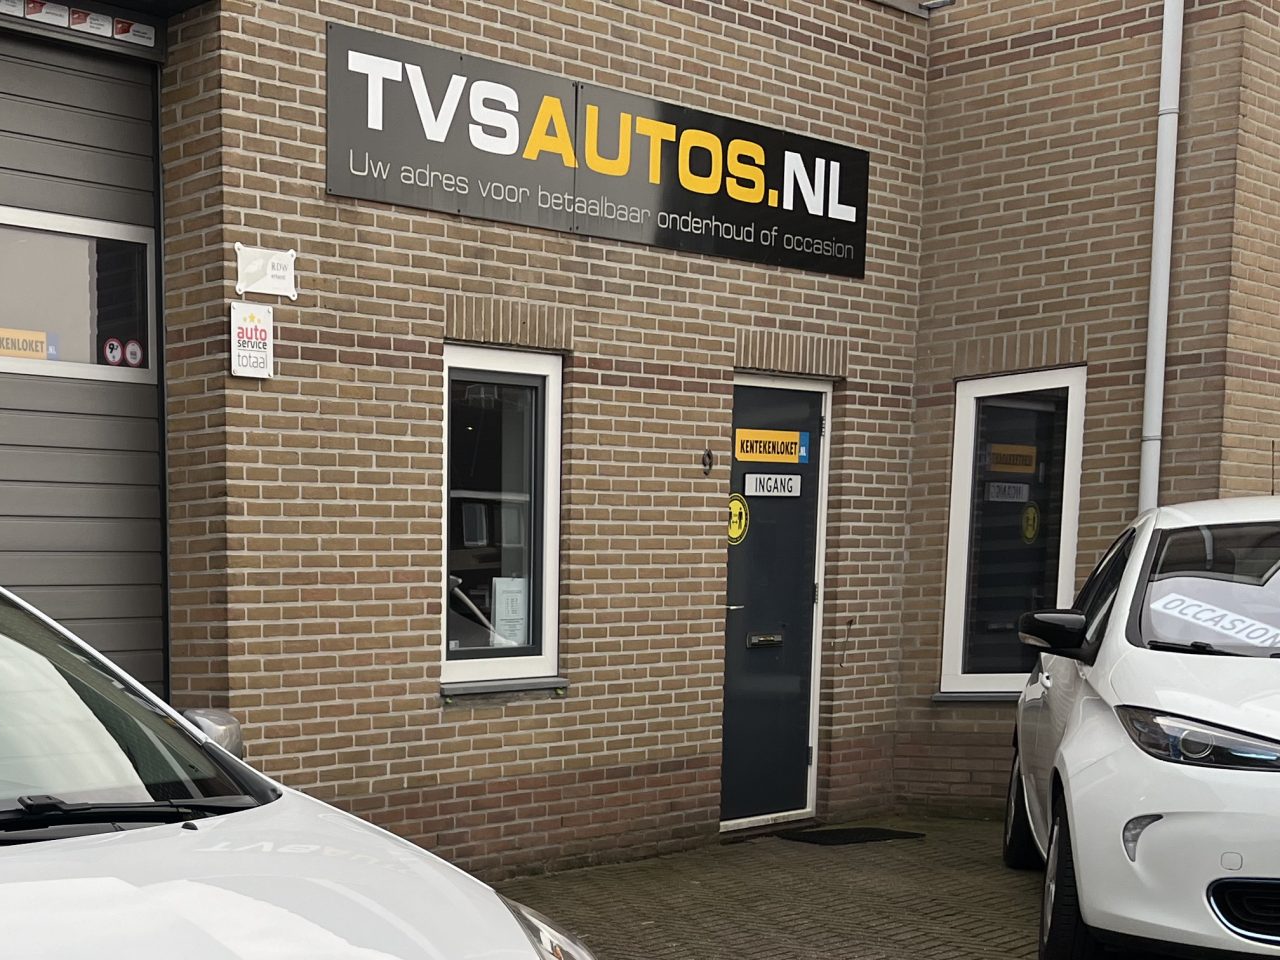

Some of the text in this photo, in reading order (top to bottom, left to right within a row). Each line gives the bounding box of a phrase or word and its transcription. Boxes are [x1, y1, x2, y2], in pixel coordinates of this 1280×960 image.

[347, 49, 857, 223] TVSAUTOS.NL
[348, 148, 855, 260] Uw adres voor betaalbaar onderhoud of occasion
[237, 325, 268, 341] auto
[237, 340, 268, 350] service
[237, 353, 268, 369] totaal
[740, 439, 798, 456] KENTEKENLOKET
[754, 477, 794, 493] INGANG
[1161, 598, 1280, 647] OCCASION
